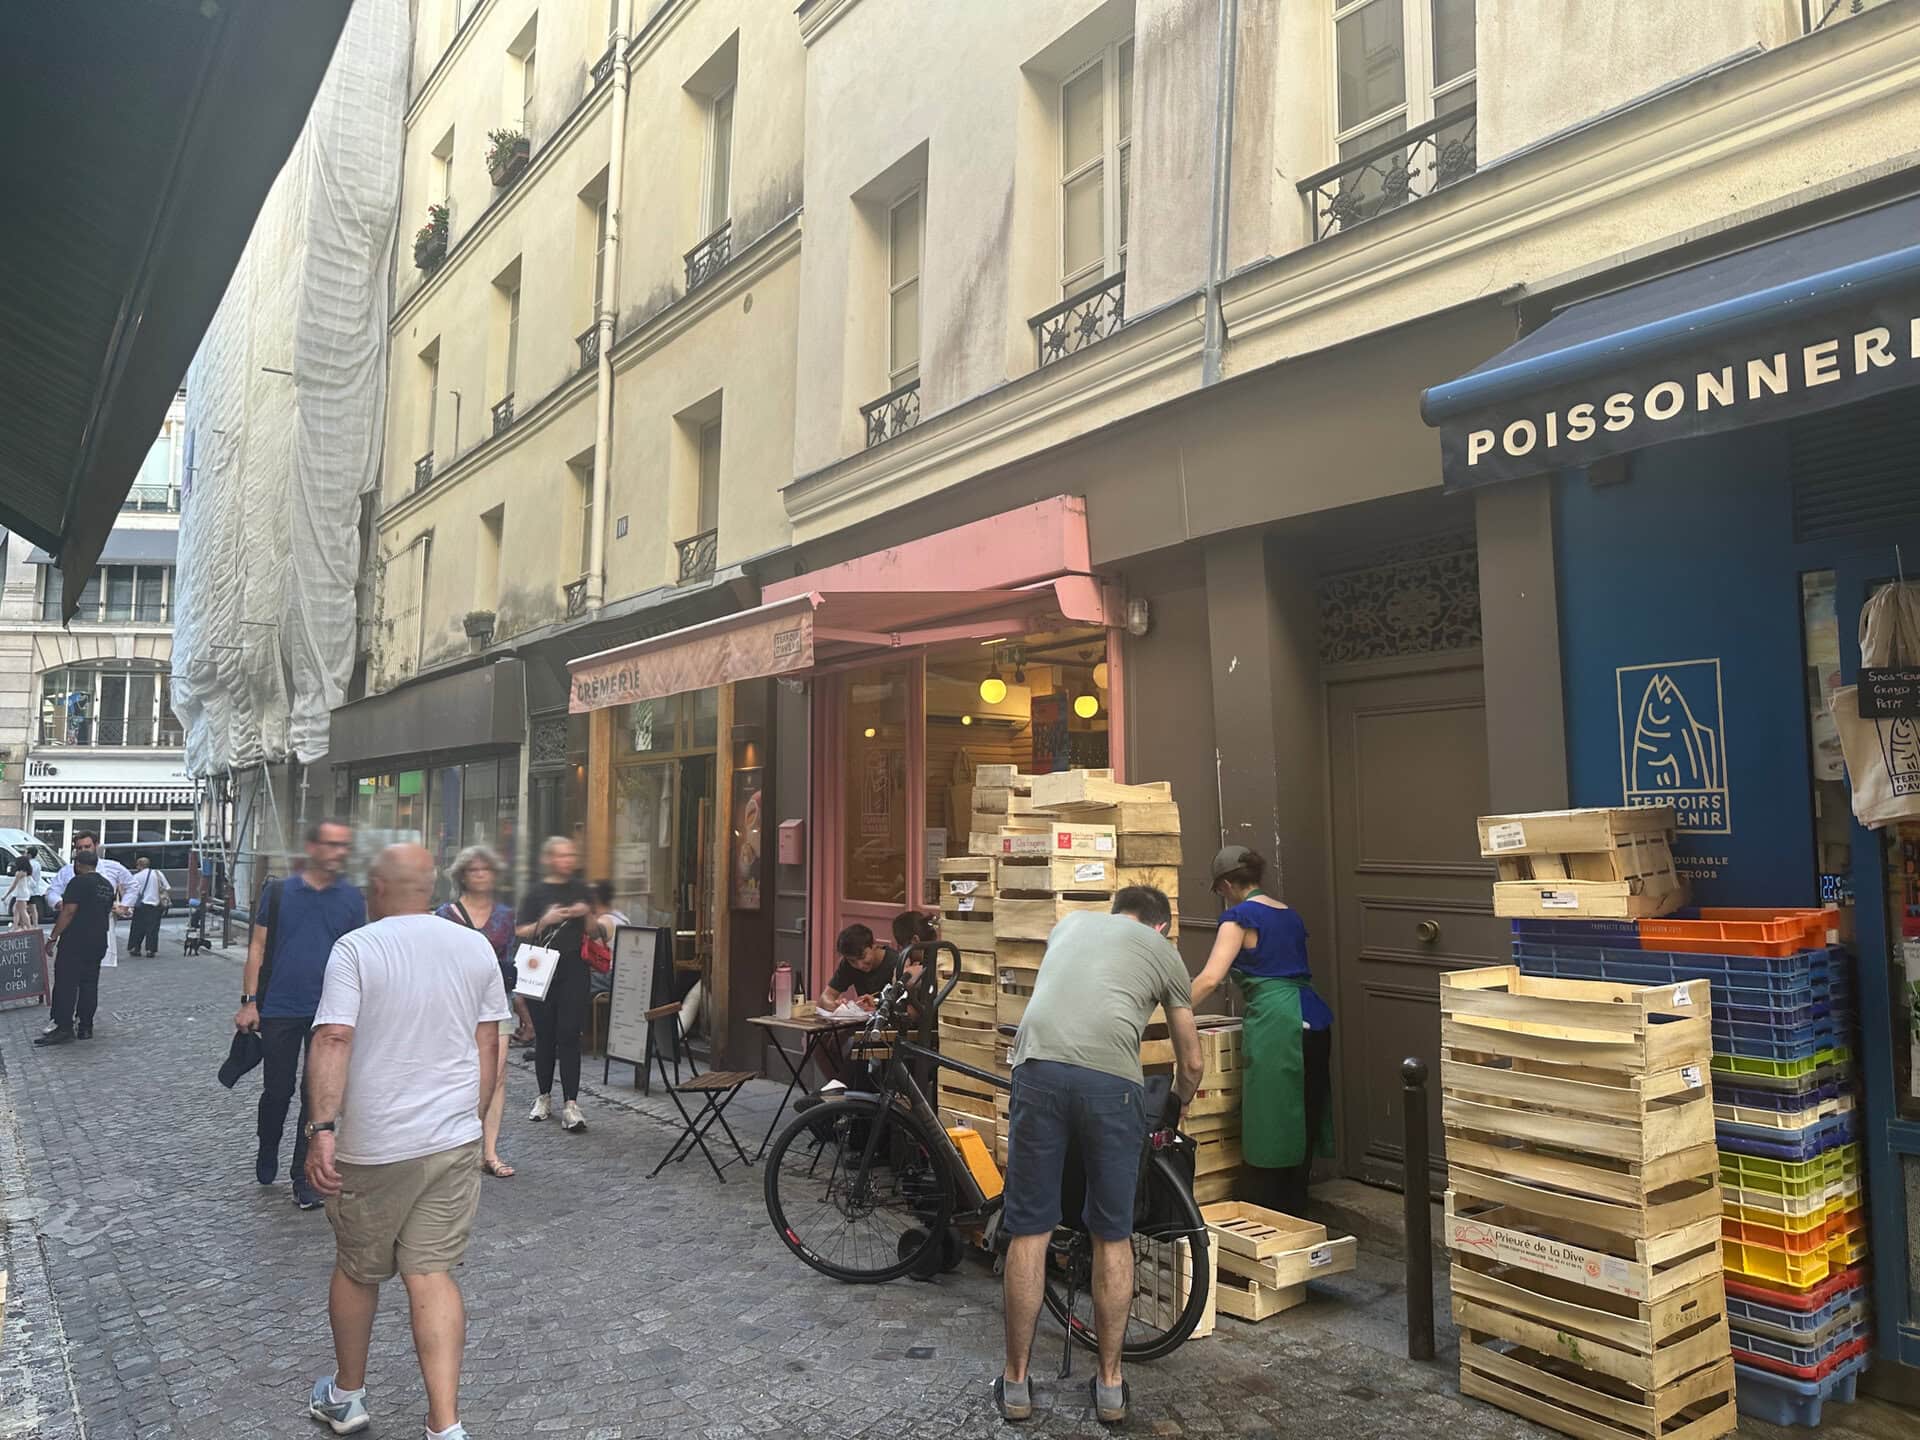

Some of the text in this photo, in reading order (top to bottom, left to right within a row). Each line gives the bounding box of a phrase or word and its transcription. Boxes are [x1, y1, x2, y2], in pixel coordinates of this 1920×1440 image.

[1676, 811, 1722, 826] ENIR
[5, 980, 27, 992] OPEN
[1495, 1231, 1530, 1249] Prieuré
[1534, 1241, 1546, 1253] de
[1550, 1245, 1560, 1257] la
[1563, 1248, 1585, 1264] Dive
